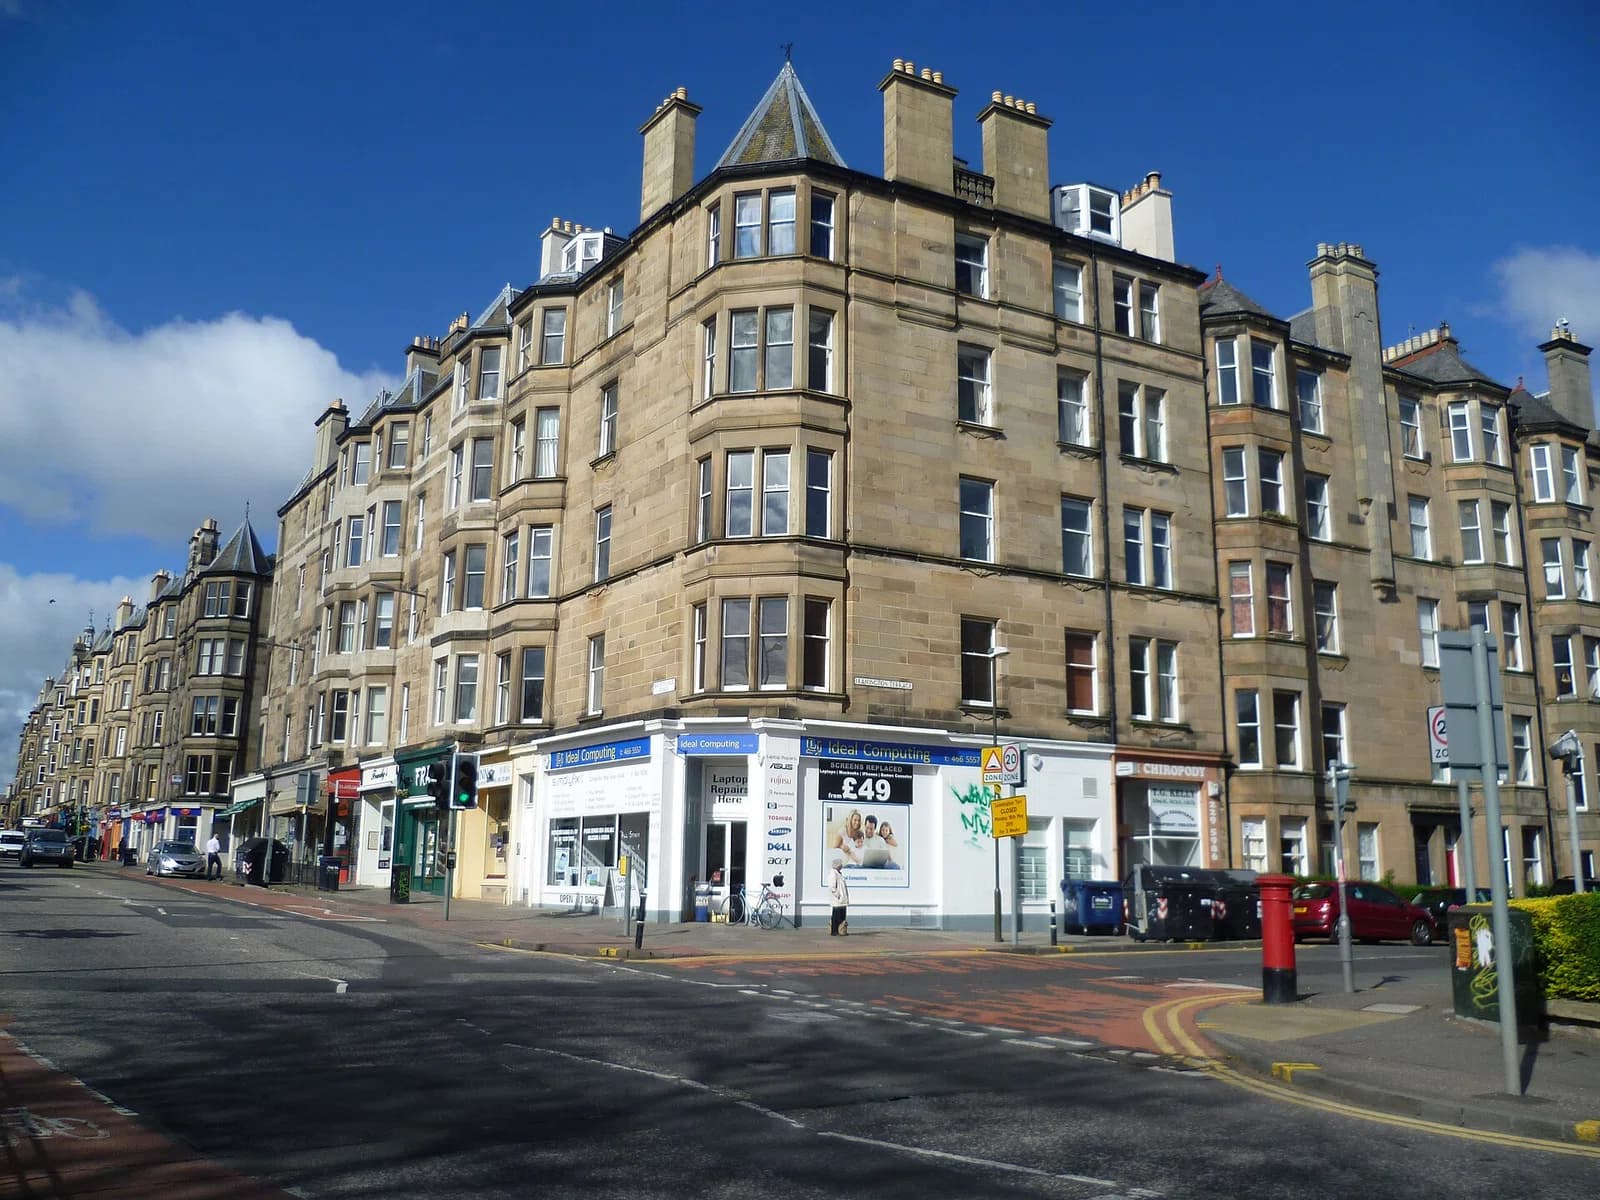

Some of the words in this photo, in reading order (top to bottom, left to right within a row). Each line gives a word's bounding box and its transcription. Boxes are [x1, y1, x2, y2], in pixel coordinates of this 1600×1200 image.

[1437, 720, 1447, 735] 2
[680, 740, 698, 748] Ideal
[700, 740, 740, 749] Computing
[565, 749, 579, 764] Ideal
[581, 745, 616, 761] Computing
[828, 741, 858, 756] Ideal
[863, 744, 931, 763] Computing
[1435, 748, 1449, 758] ZO
[1005, 753, 1017, 765] 20
[831, 762, 864, 770] SCREENS
[865, 764, 903, 773] REPLACED
[1143, 763, 1206, 776] CHIROPODY
[713, 774, 748, 786] Laptop
[1004, 773, 1018, 781] ZONE
[711, 785, 748, 797] Repairs
[842, 777, 891, 801] £49
[718, 795, 742, 804] Here
[1000, 806, 1018, 814] CLOSED
[767, 843, 793, 851] DELL
[767, 856, 792, 865] acer
[560, 894, 573, 904] OPEN
